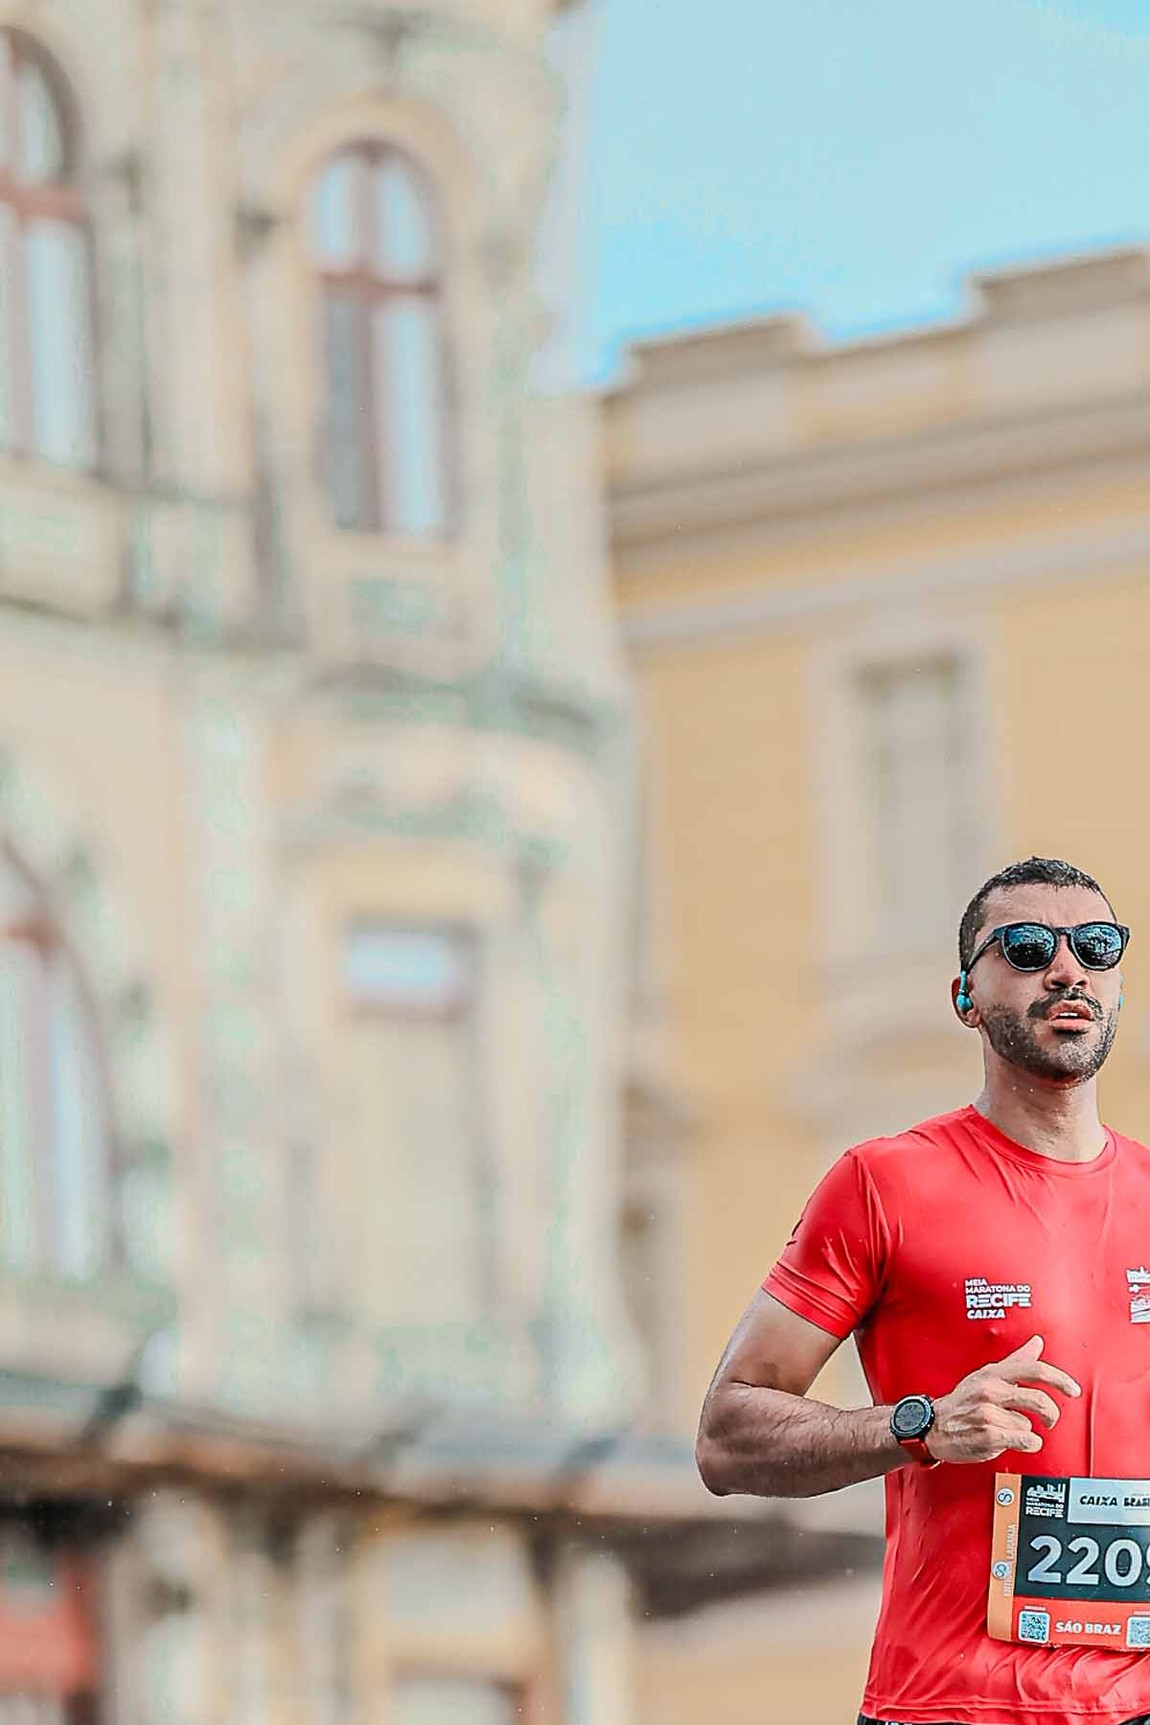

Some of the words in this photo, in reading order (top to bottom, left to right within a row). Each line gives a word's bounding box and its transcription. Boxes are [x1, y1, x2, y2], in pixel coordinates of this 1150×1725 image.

[966, 1286, 1016, 1294] MARATONA
[966, 1294, 1032, 1308] RECIFE
[967, 1309, 1006, 1319] CAIXA
[1080, 1496, 1118, 1506] CAIXA
[1026, 1507, 1064, 1518] RECIFE
[1085, 1623, 1121, 1636] BRAZ
